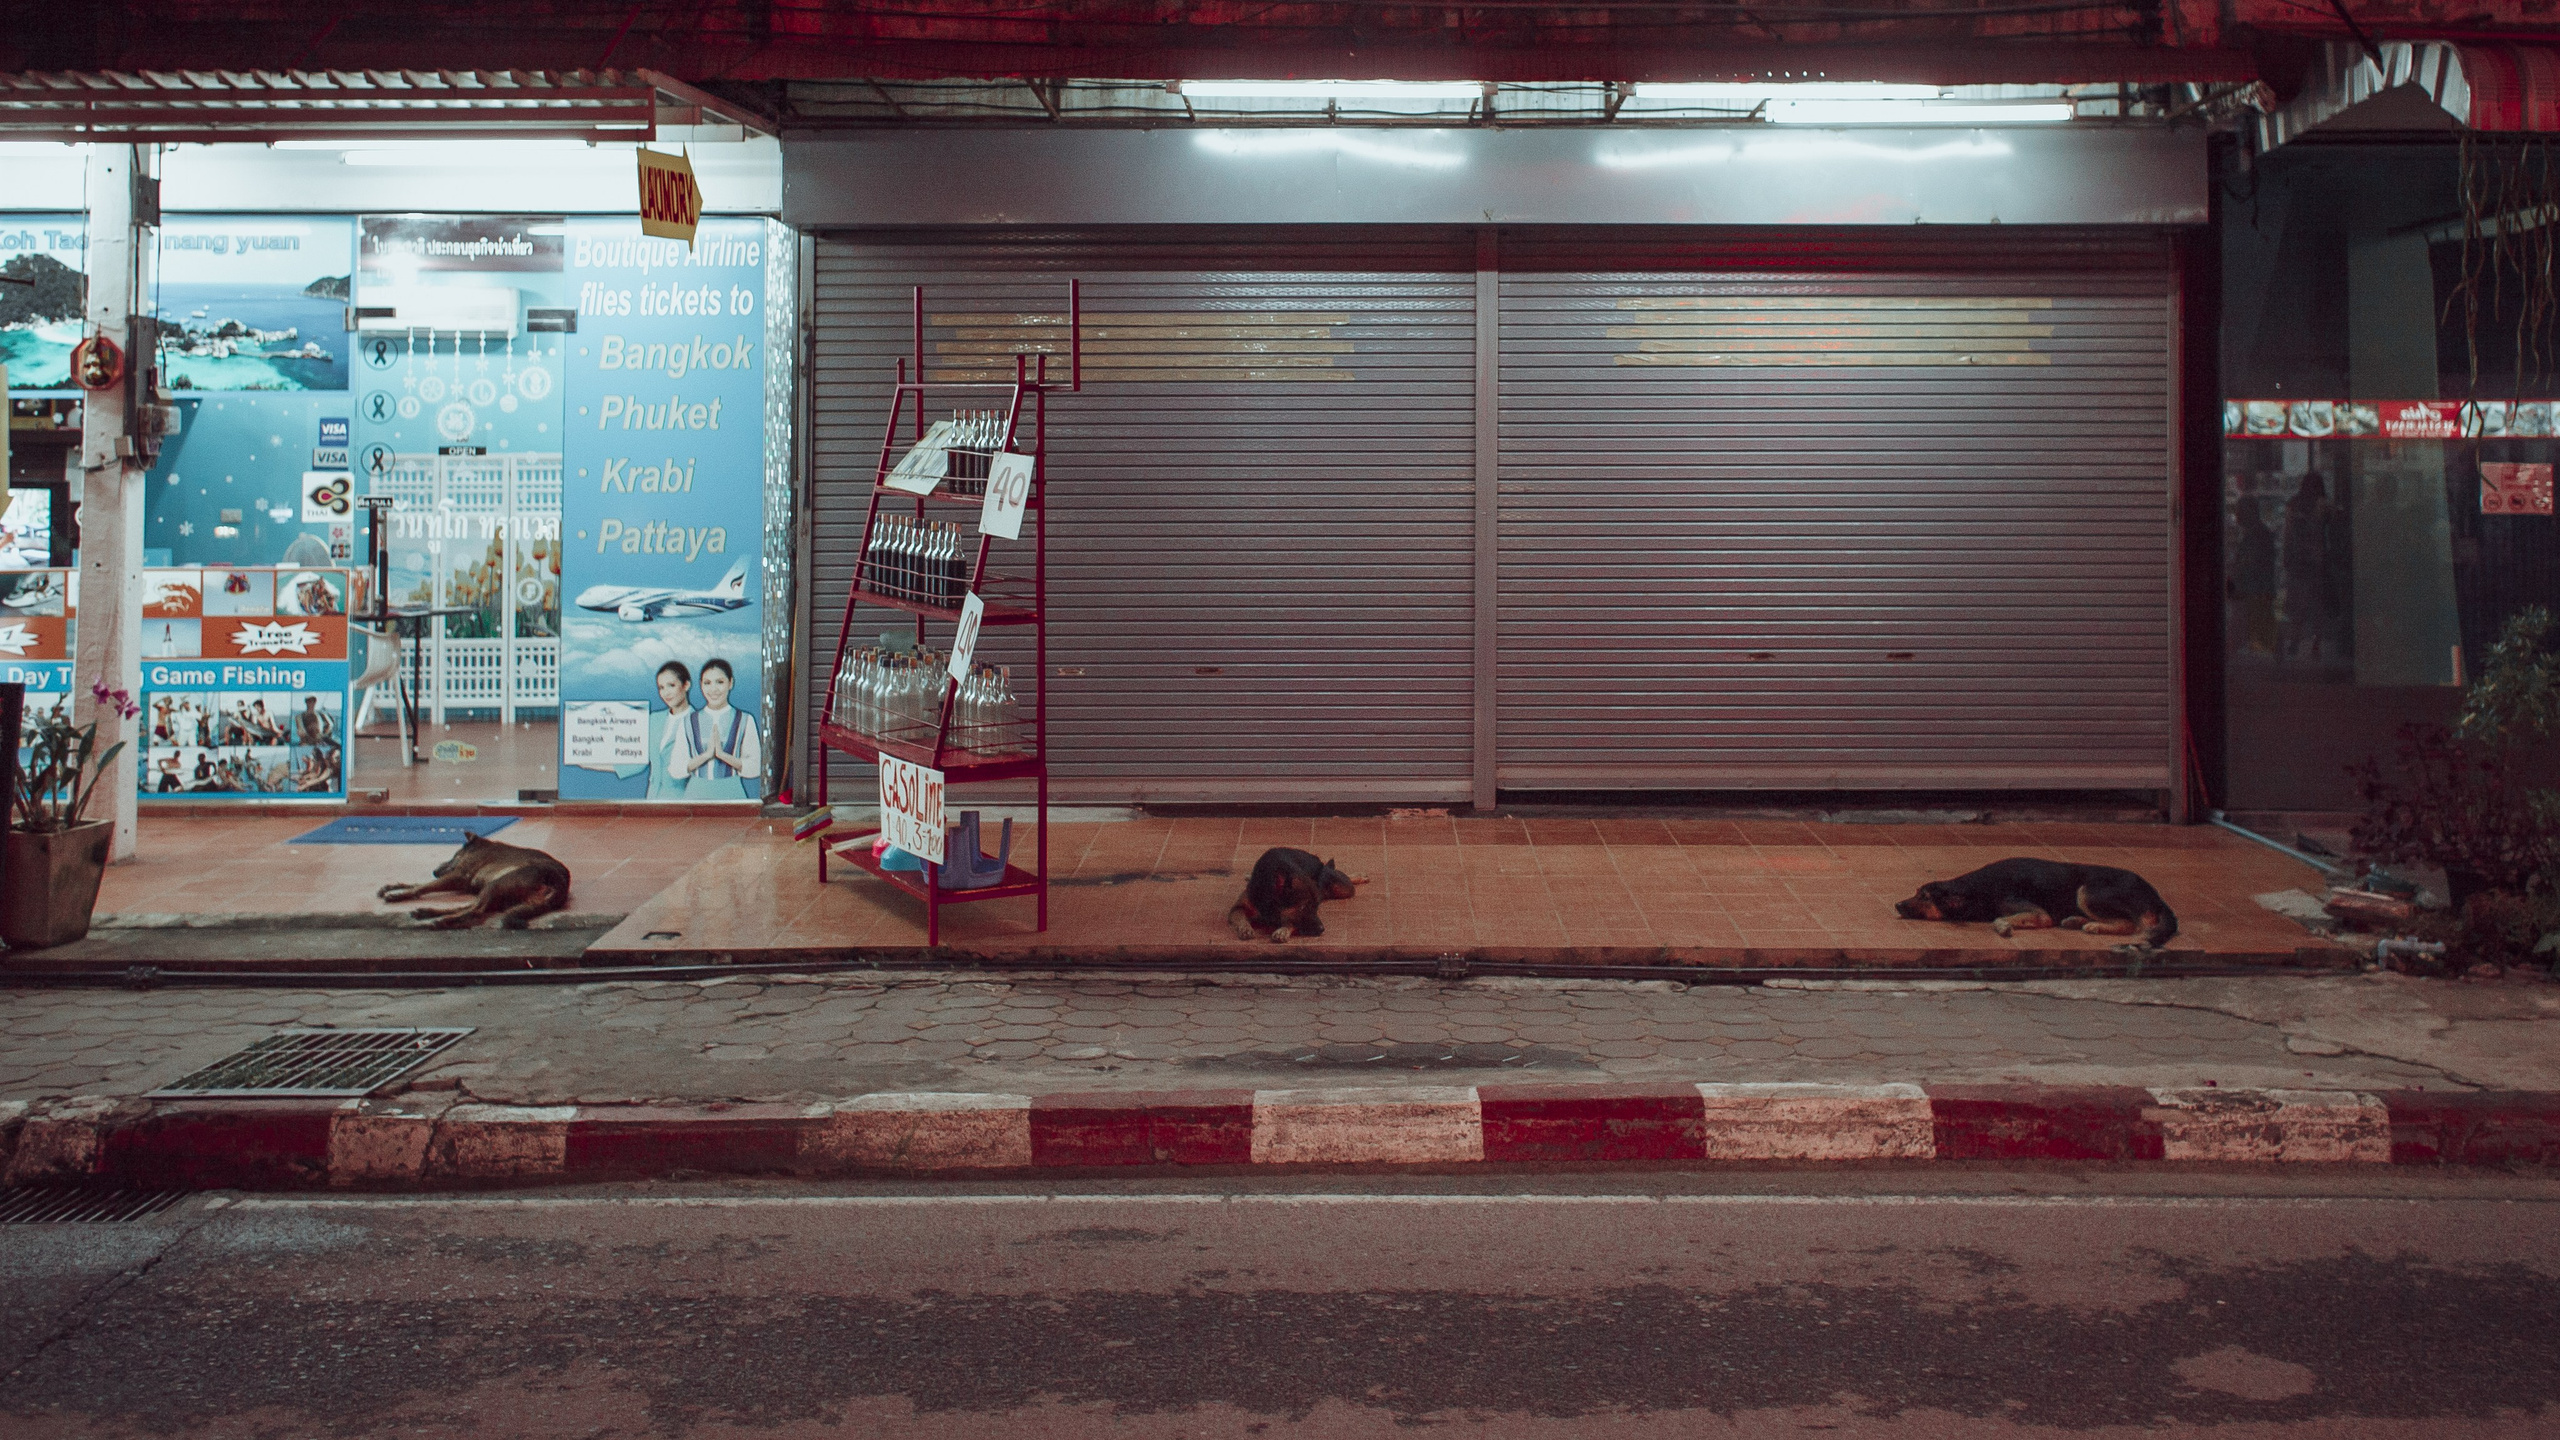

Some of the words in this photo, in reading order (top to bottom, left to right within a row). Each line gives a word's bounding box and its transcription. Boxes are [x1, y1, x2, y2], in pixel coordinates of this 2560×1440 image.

[640, 164, 695, 226] LAUNDRY
[164, 235, 229, 255] nang
[236, 235, 301, 255] yuan
[574, 235, 680, 275] Boutique
[684, 234, 761, 267] Airline
[580, 281, 632, 316] flies
[640, 281, 722, 316] tickets
[730, 283, 754, 316] to
[600, 334, 755, 379] Bangkok
[598, 394, 723, 431] Phuket
[321, 423, 347, 435] VISA
[318, 452, 347, 463] VISA
[449, 447, 476, 455] OPEN
[601, 457, 697, 494] Krabi
[993, 466, 1026, 512] 40
[597, 518, 727, 563] Pattaya
[958, 610, 978, 661] 40
[7, 667, 50, 689] Day
[151, 666, 216, 685] Game
[223, 666, 306, 689] Fishing
[577, 717, 607, 725] Bangkok
[572, 735, 604, 744] Bangkok
[615, 735, 641, 743] Phuket
[572, 748, 592, 756] Krabi
[615, 748, 642, 757] Pattaya
